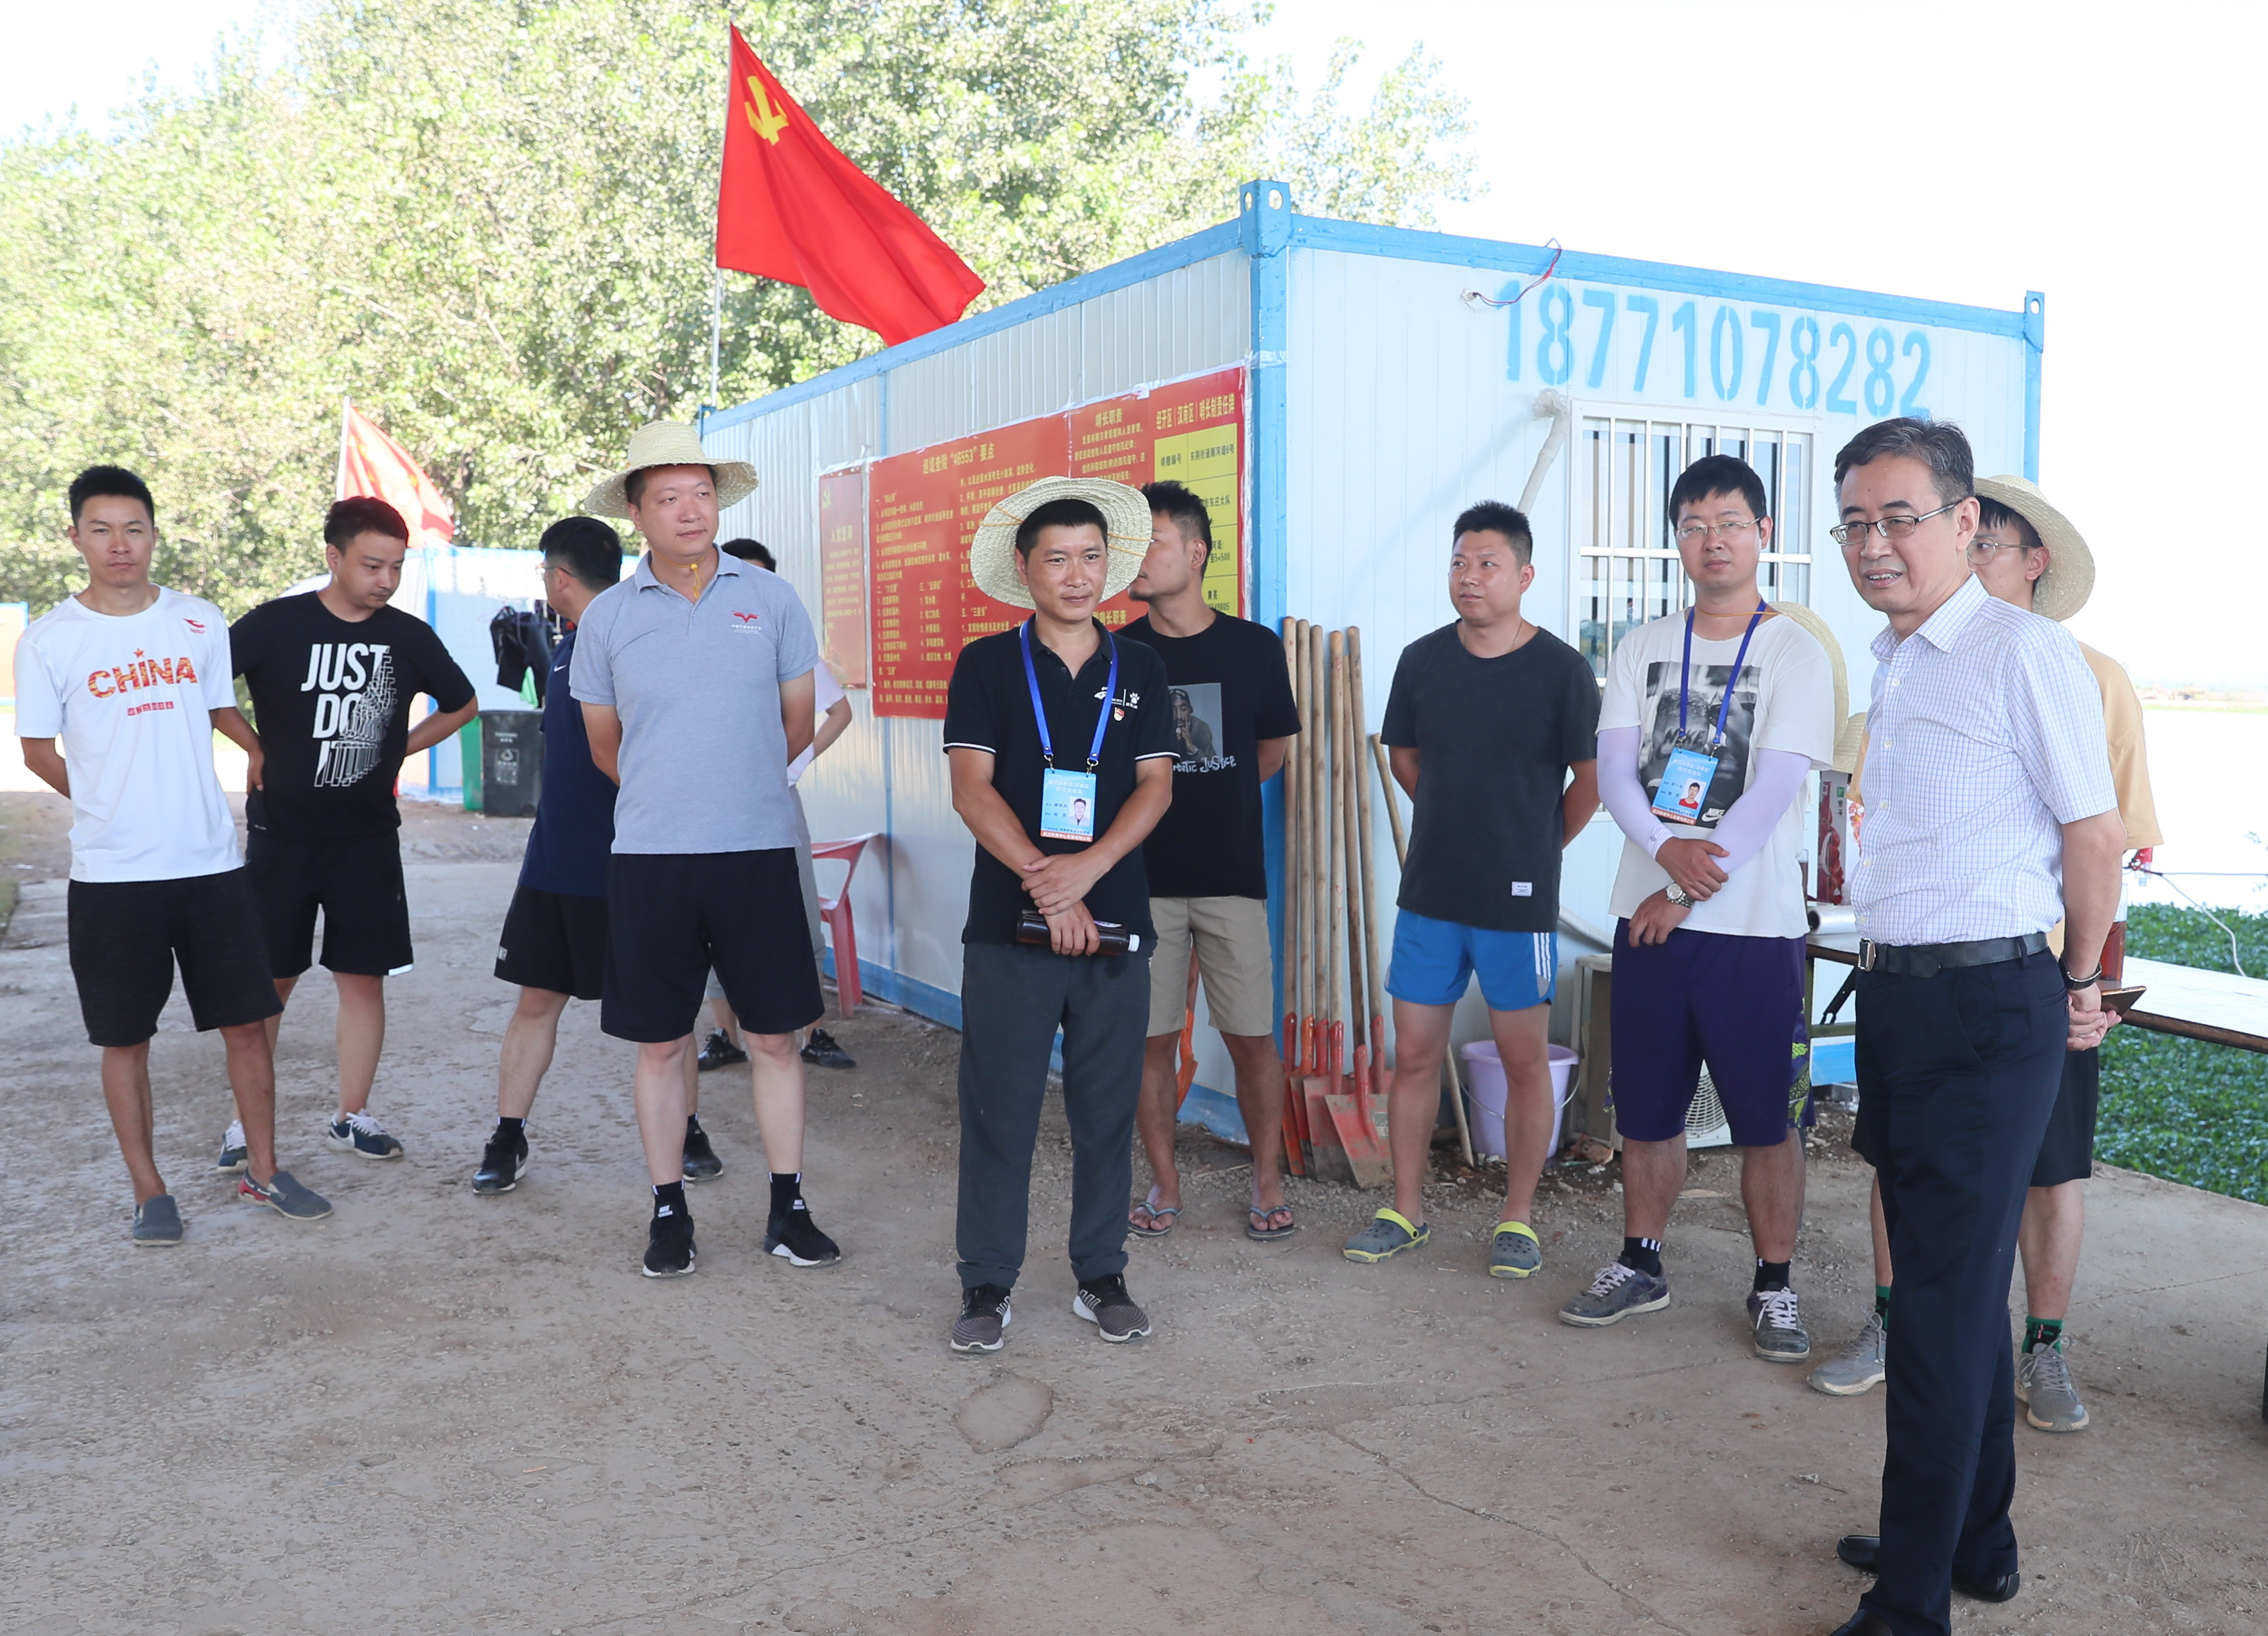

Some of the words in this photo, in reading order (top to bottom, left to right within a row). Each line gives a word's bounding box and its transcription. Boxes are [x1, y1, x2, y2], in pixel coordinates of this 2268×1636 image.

[1498, 279, 1931, 418] 18771078282
[88, 657, 199, 698] CHINA
[300, 642, 391, 692] JUST
[312, 692, 363, 739] DO
[1706, 807, 1726, 817] NIKE
